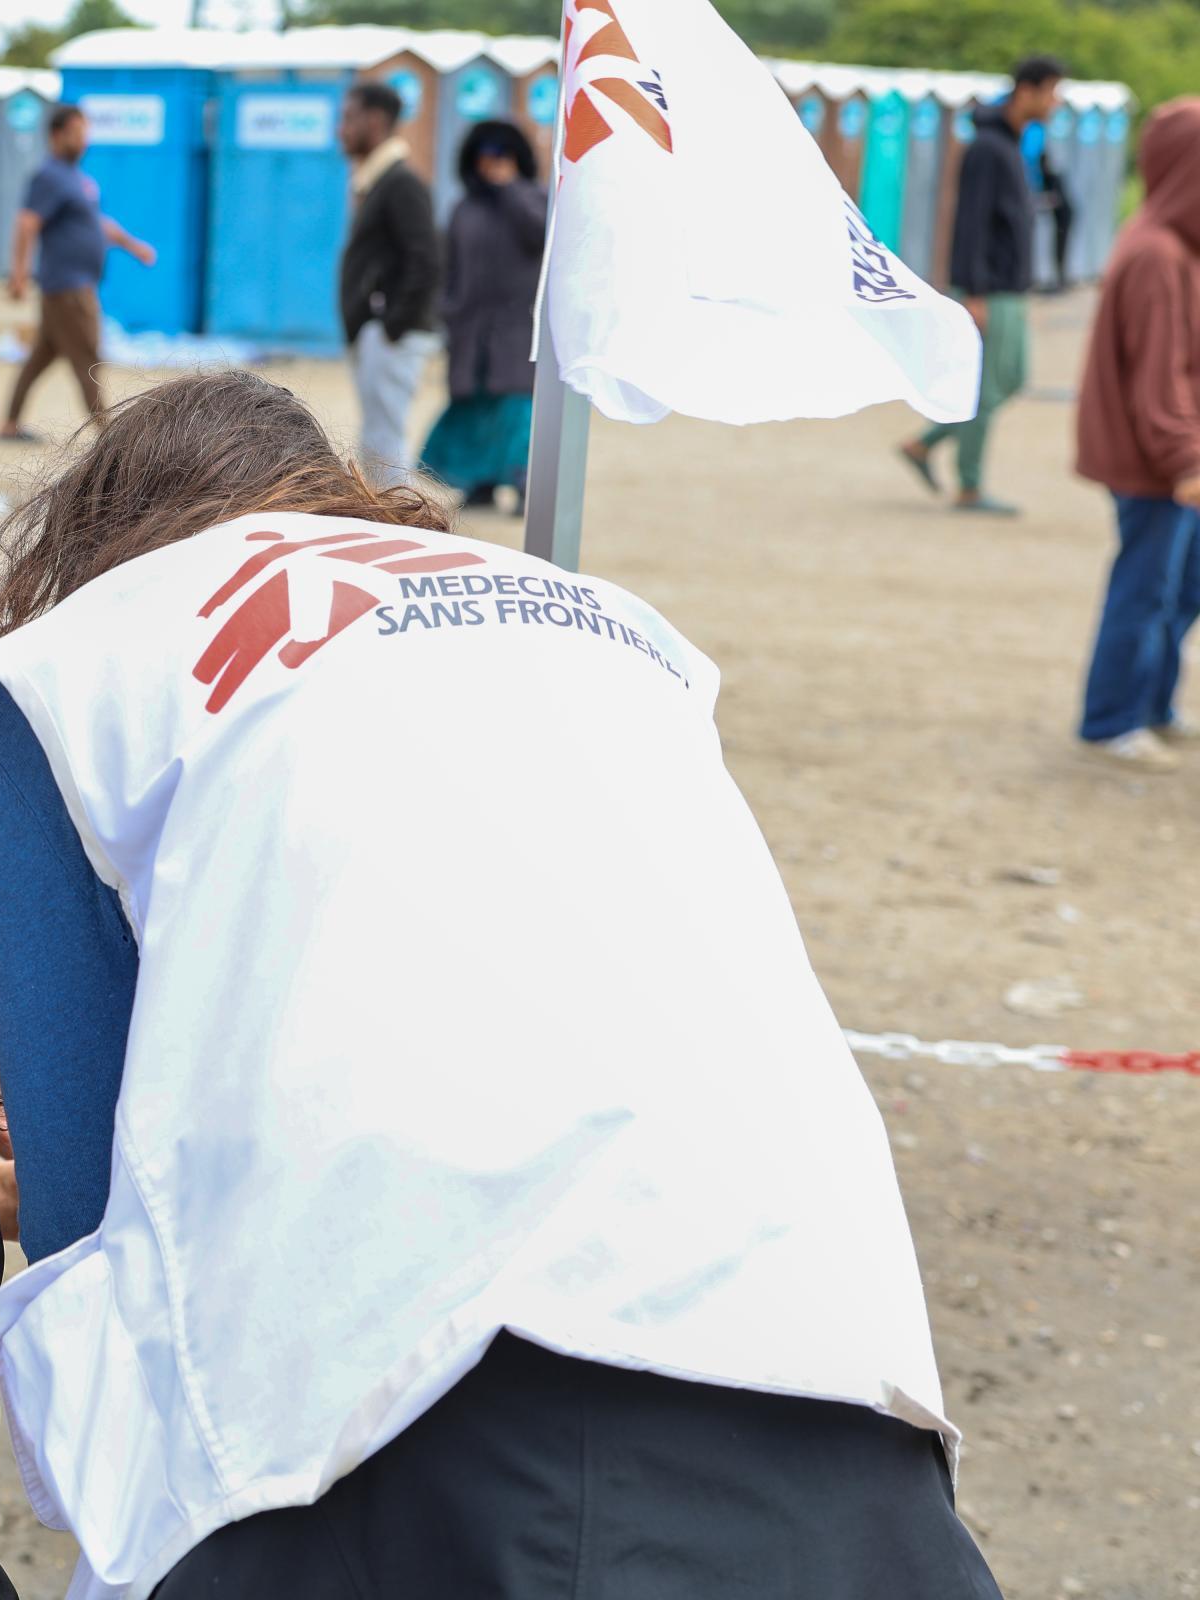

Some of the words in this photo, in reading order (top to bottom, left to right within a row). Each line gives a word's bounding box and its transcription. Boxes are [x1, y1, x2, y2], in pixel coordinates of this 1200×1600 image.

[399, 575, 601, 610] MEDECINS
[376, 600, 485, 635] SANS
[495, 600, 689, 690] FRONTIER
